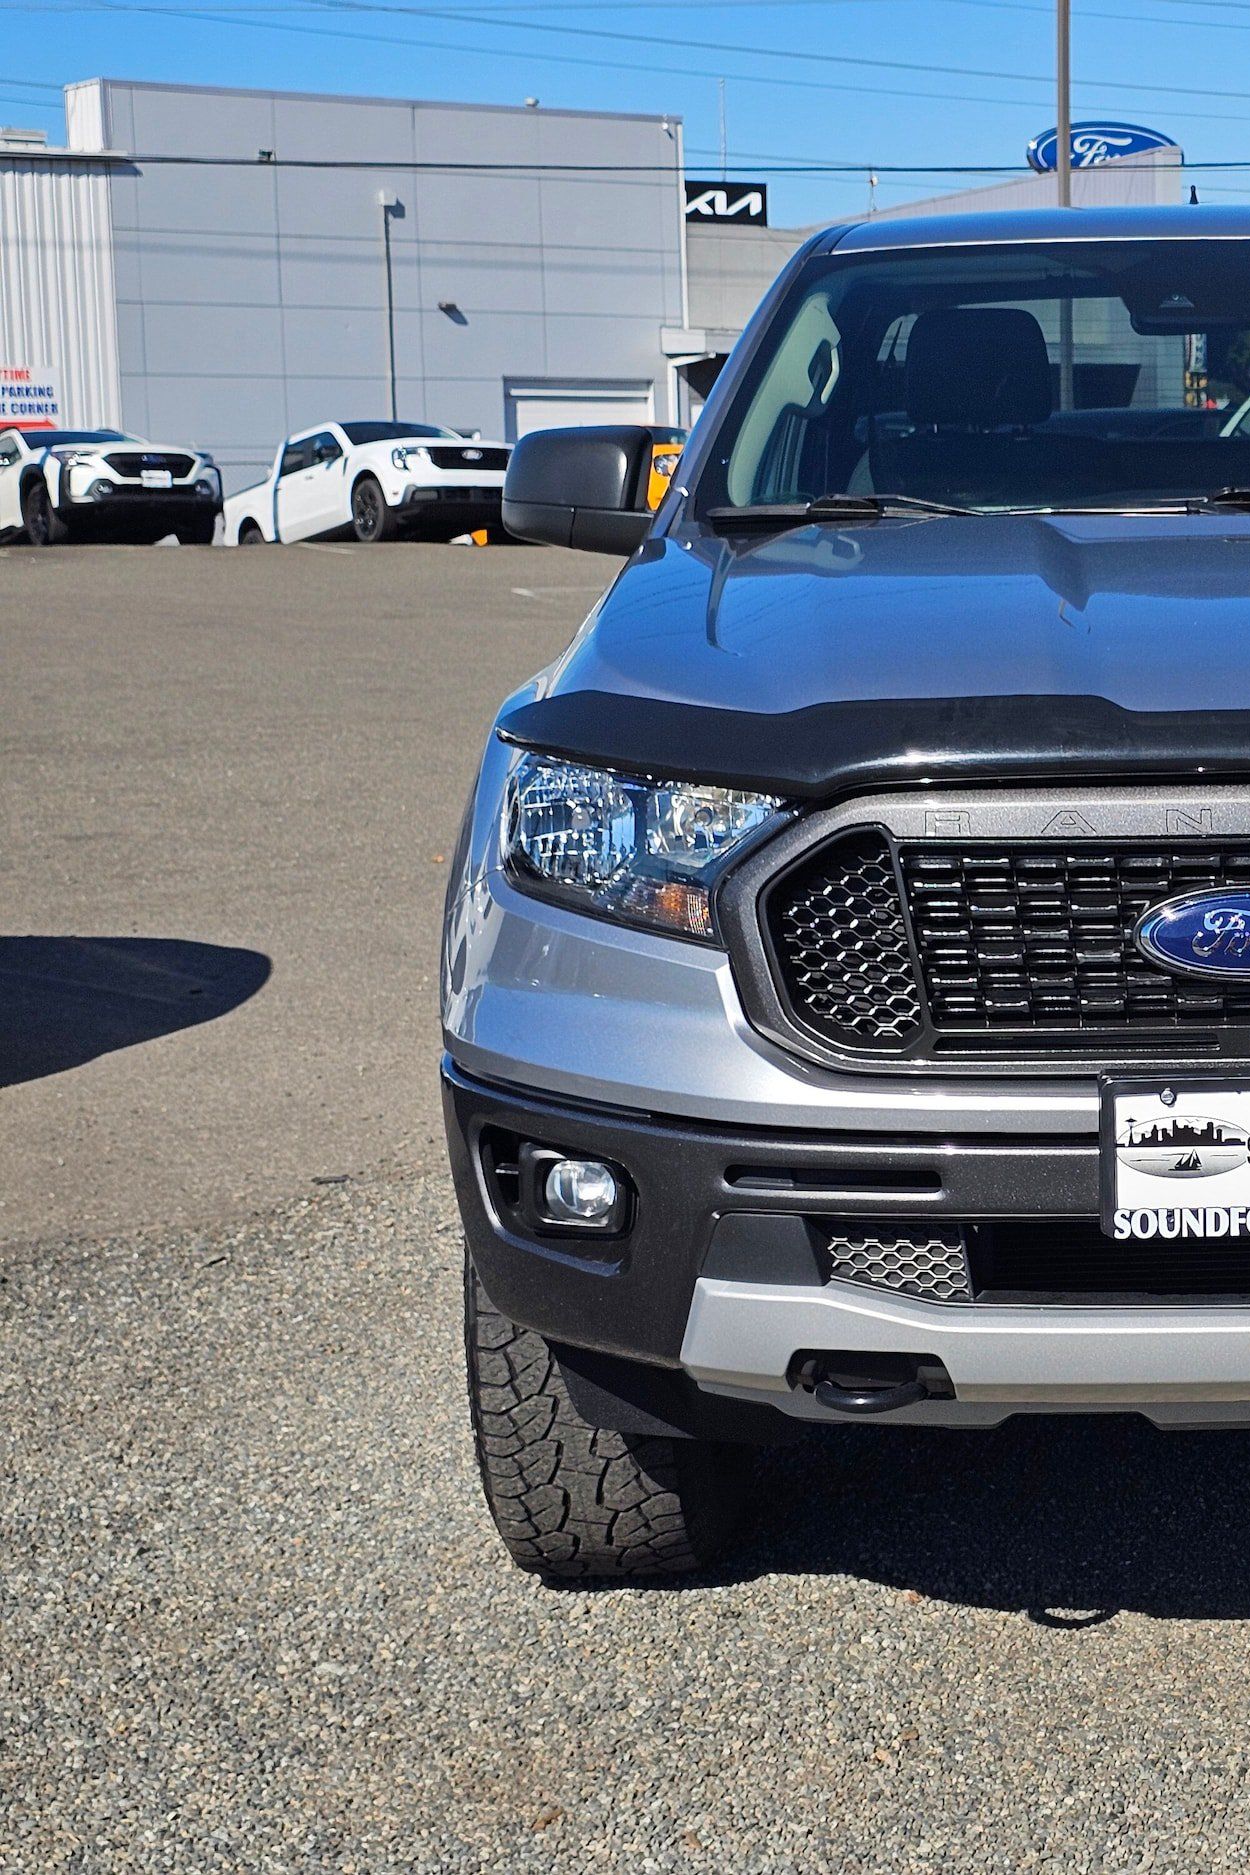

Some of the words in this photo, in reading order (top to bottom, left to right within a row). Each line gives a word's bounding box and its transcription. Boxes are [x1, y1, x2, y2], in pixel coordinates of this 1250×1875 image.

[684, 190, 762, 217] KIA
[0, 370, 30, 381] TIME
[1, 386, 54, 398] PARKING
[11, 402, 58, 415] CORNER
